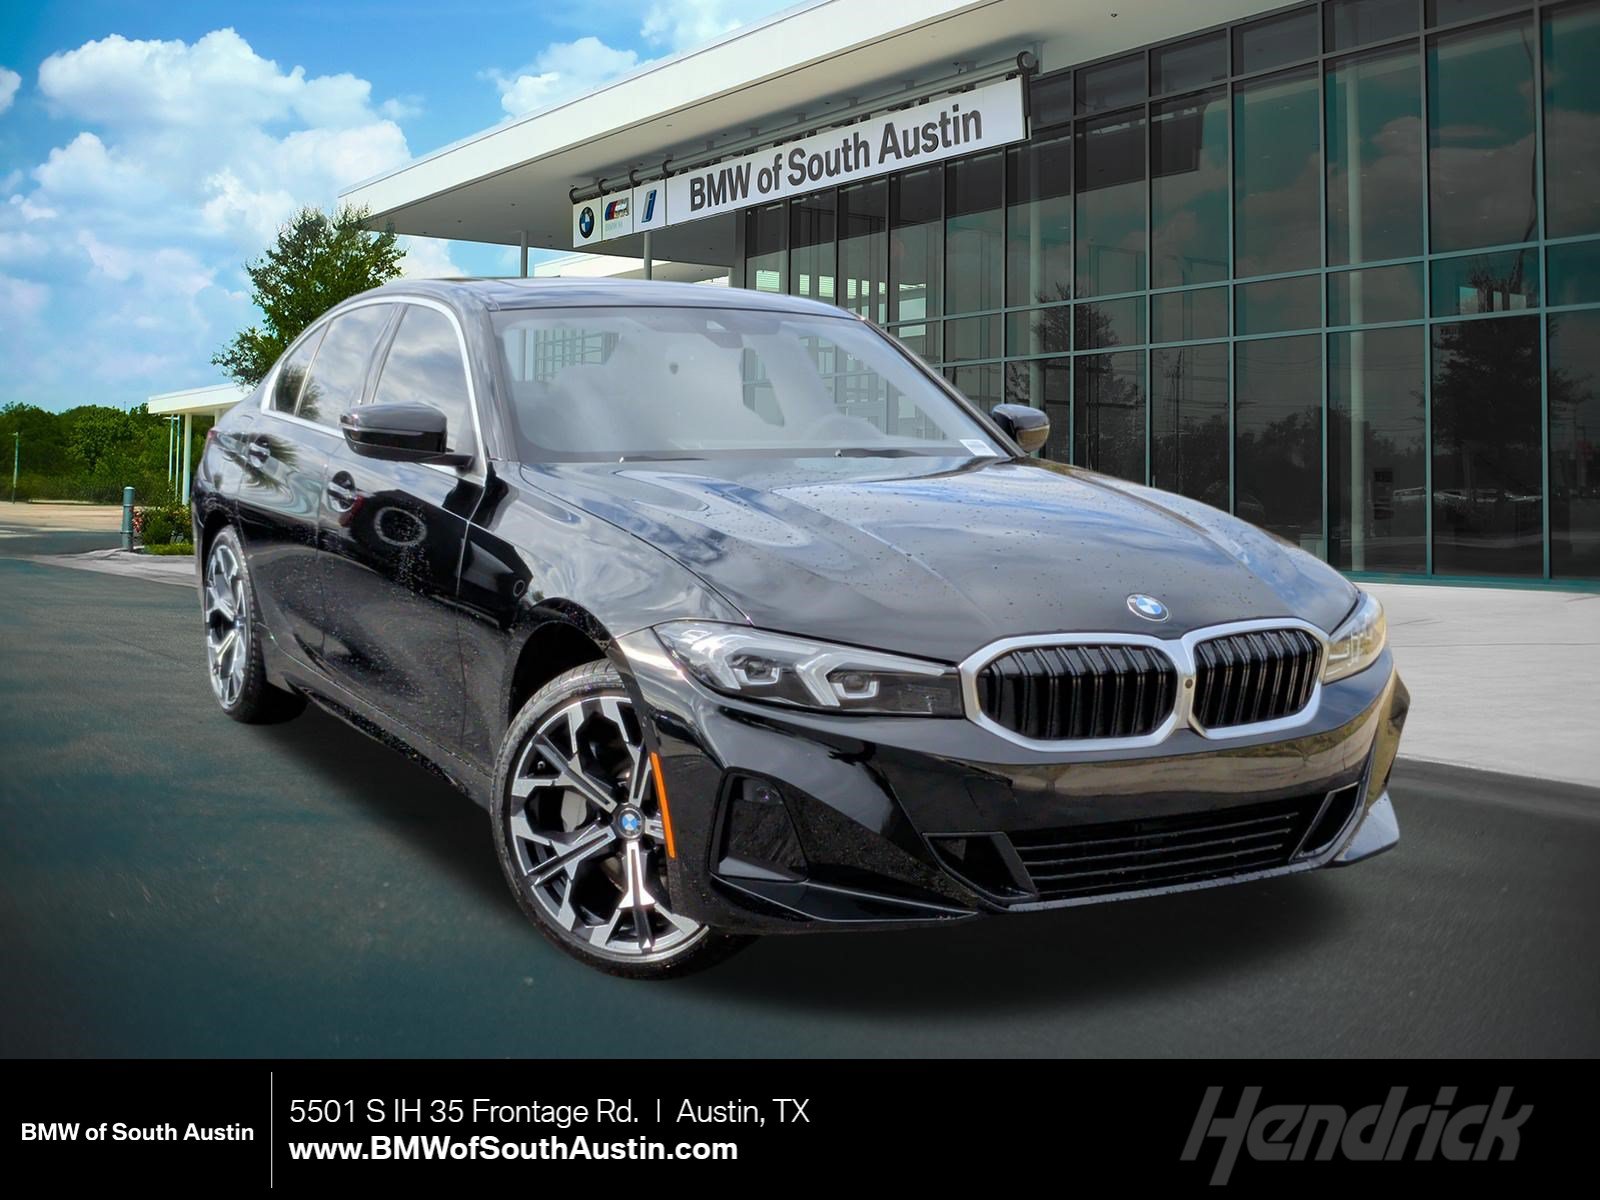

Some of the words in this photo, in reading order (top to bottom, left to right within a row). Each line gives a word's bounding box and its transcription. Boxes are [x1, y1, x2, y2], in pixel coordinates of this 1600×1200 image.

[690, 161, 751, 212] BMW
[757, 153, 783, 194] of
[787, 131, 871, 187] South
[878, 103, 983, 165] Austin
